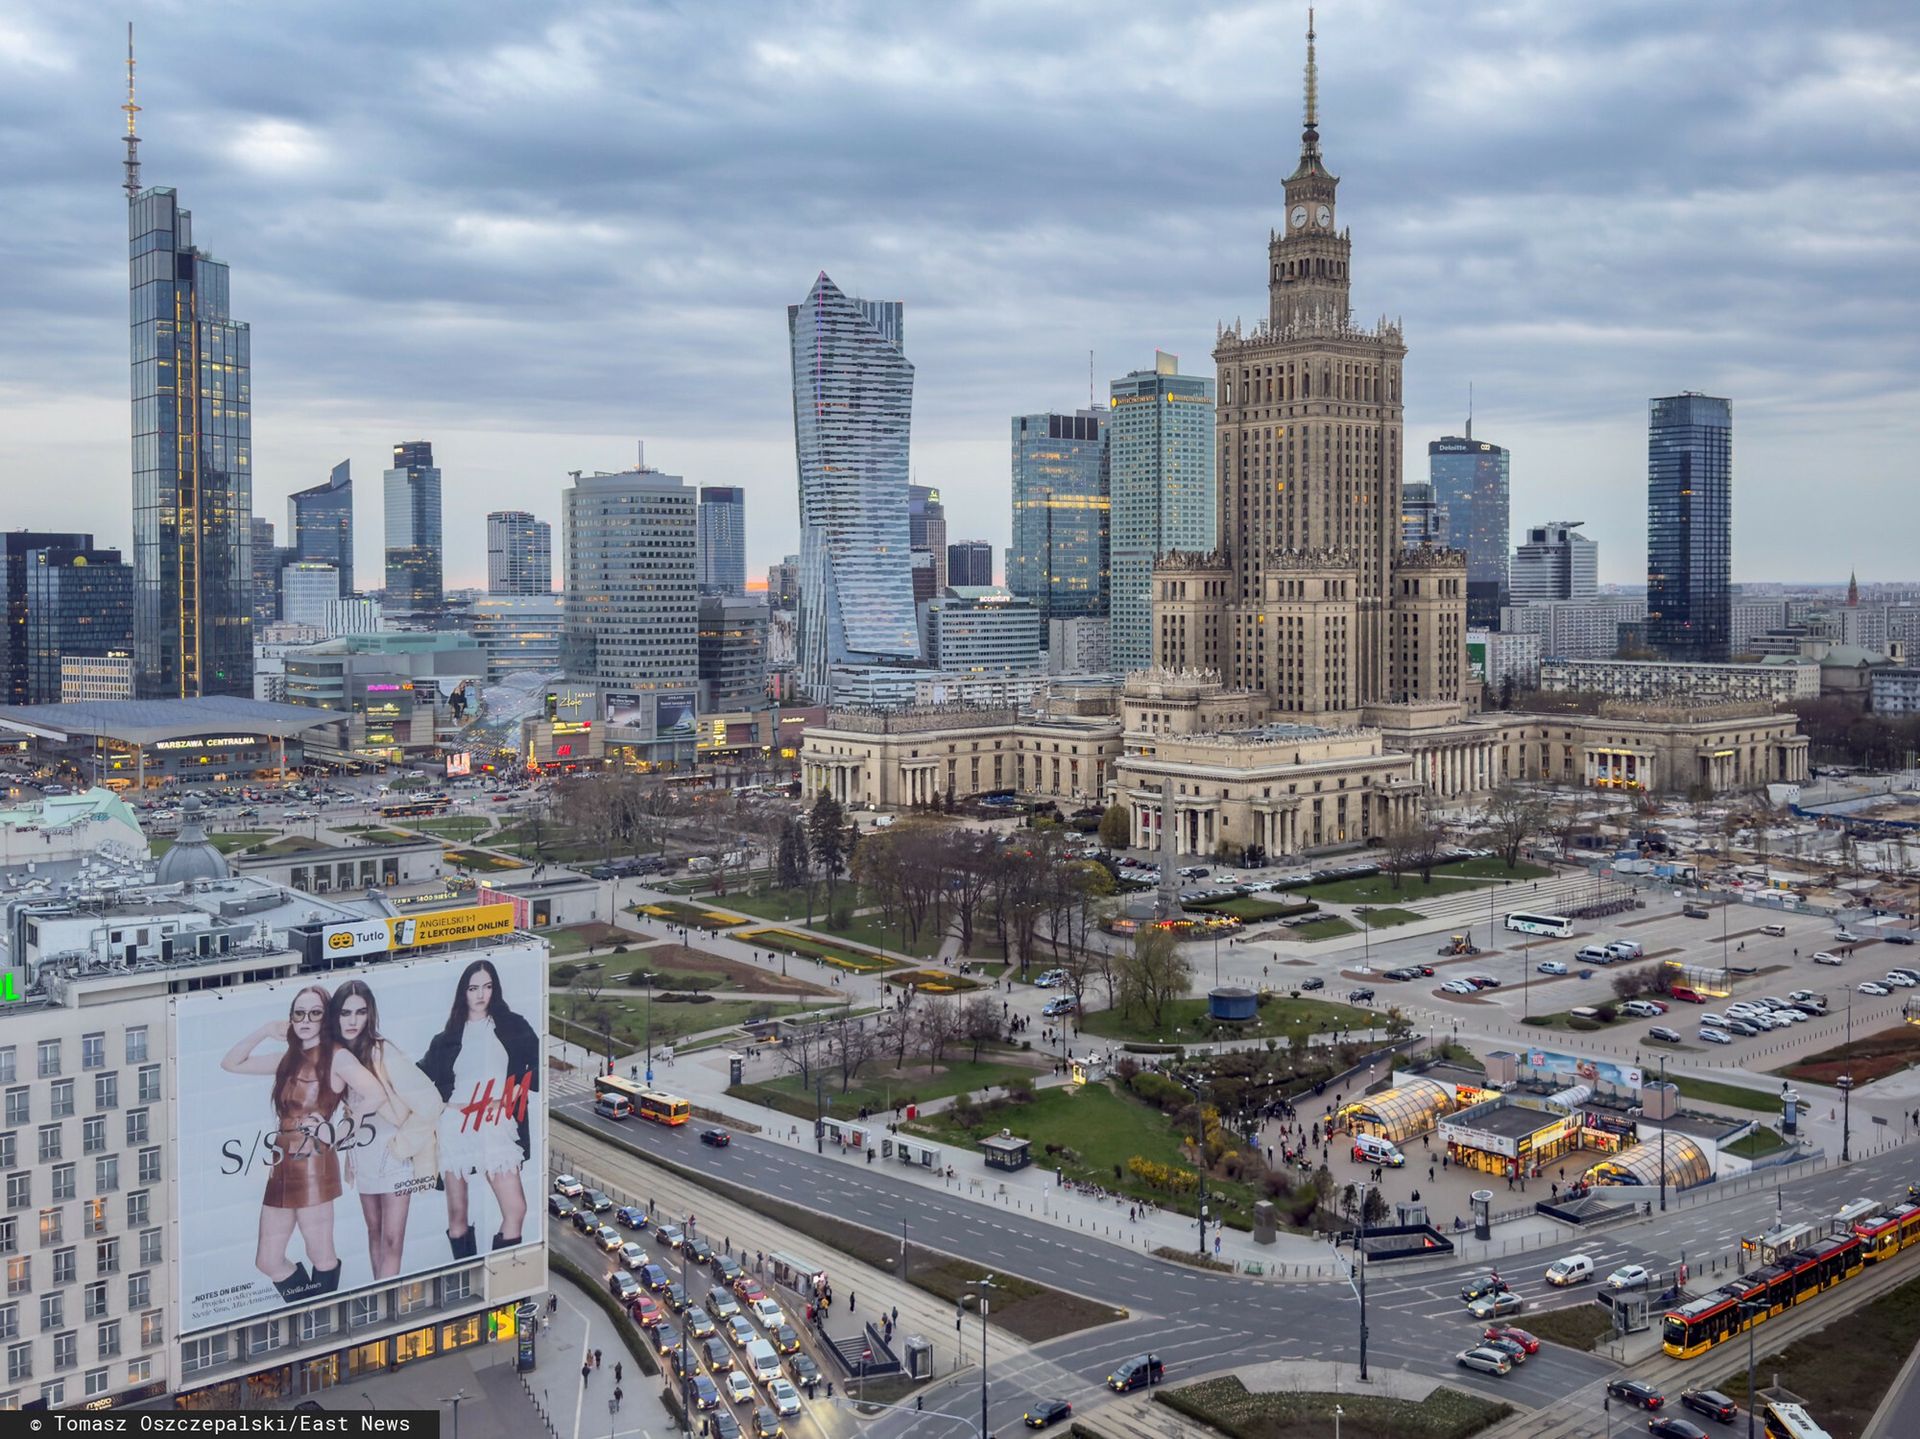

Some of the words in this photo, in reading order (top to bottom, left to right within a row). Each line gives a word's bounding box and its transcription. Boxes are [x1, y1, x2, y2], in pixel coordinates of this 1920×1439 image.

[156, 740, 204, 750] WARSZAWA
[206, 737, 255, 747] CENTRALNA
[419, 915, 465, 929] ANGIELSKI
[419, 931, 426, 939] Z
[427, 925, 475, 939] LEKTOREM
[477, 919, 510, 932] ONLINE
[356, 931, 385, 943] Tutlo
[460, 1071, 533, 1133] H&M
[296, 1112, 377, 1159] 2025
[394, 1175, 435, 1190] SPÓDNICA
[219, 1288, 230, 1297] ON
